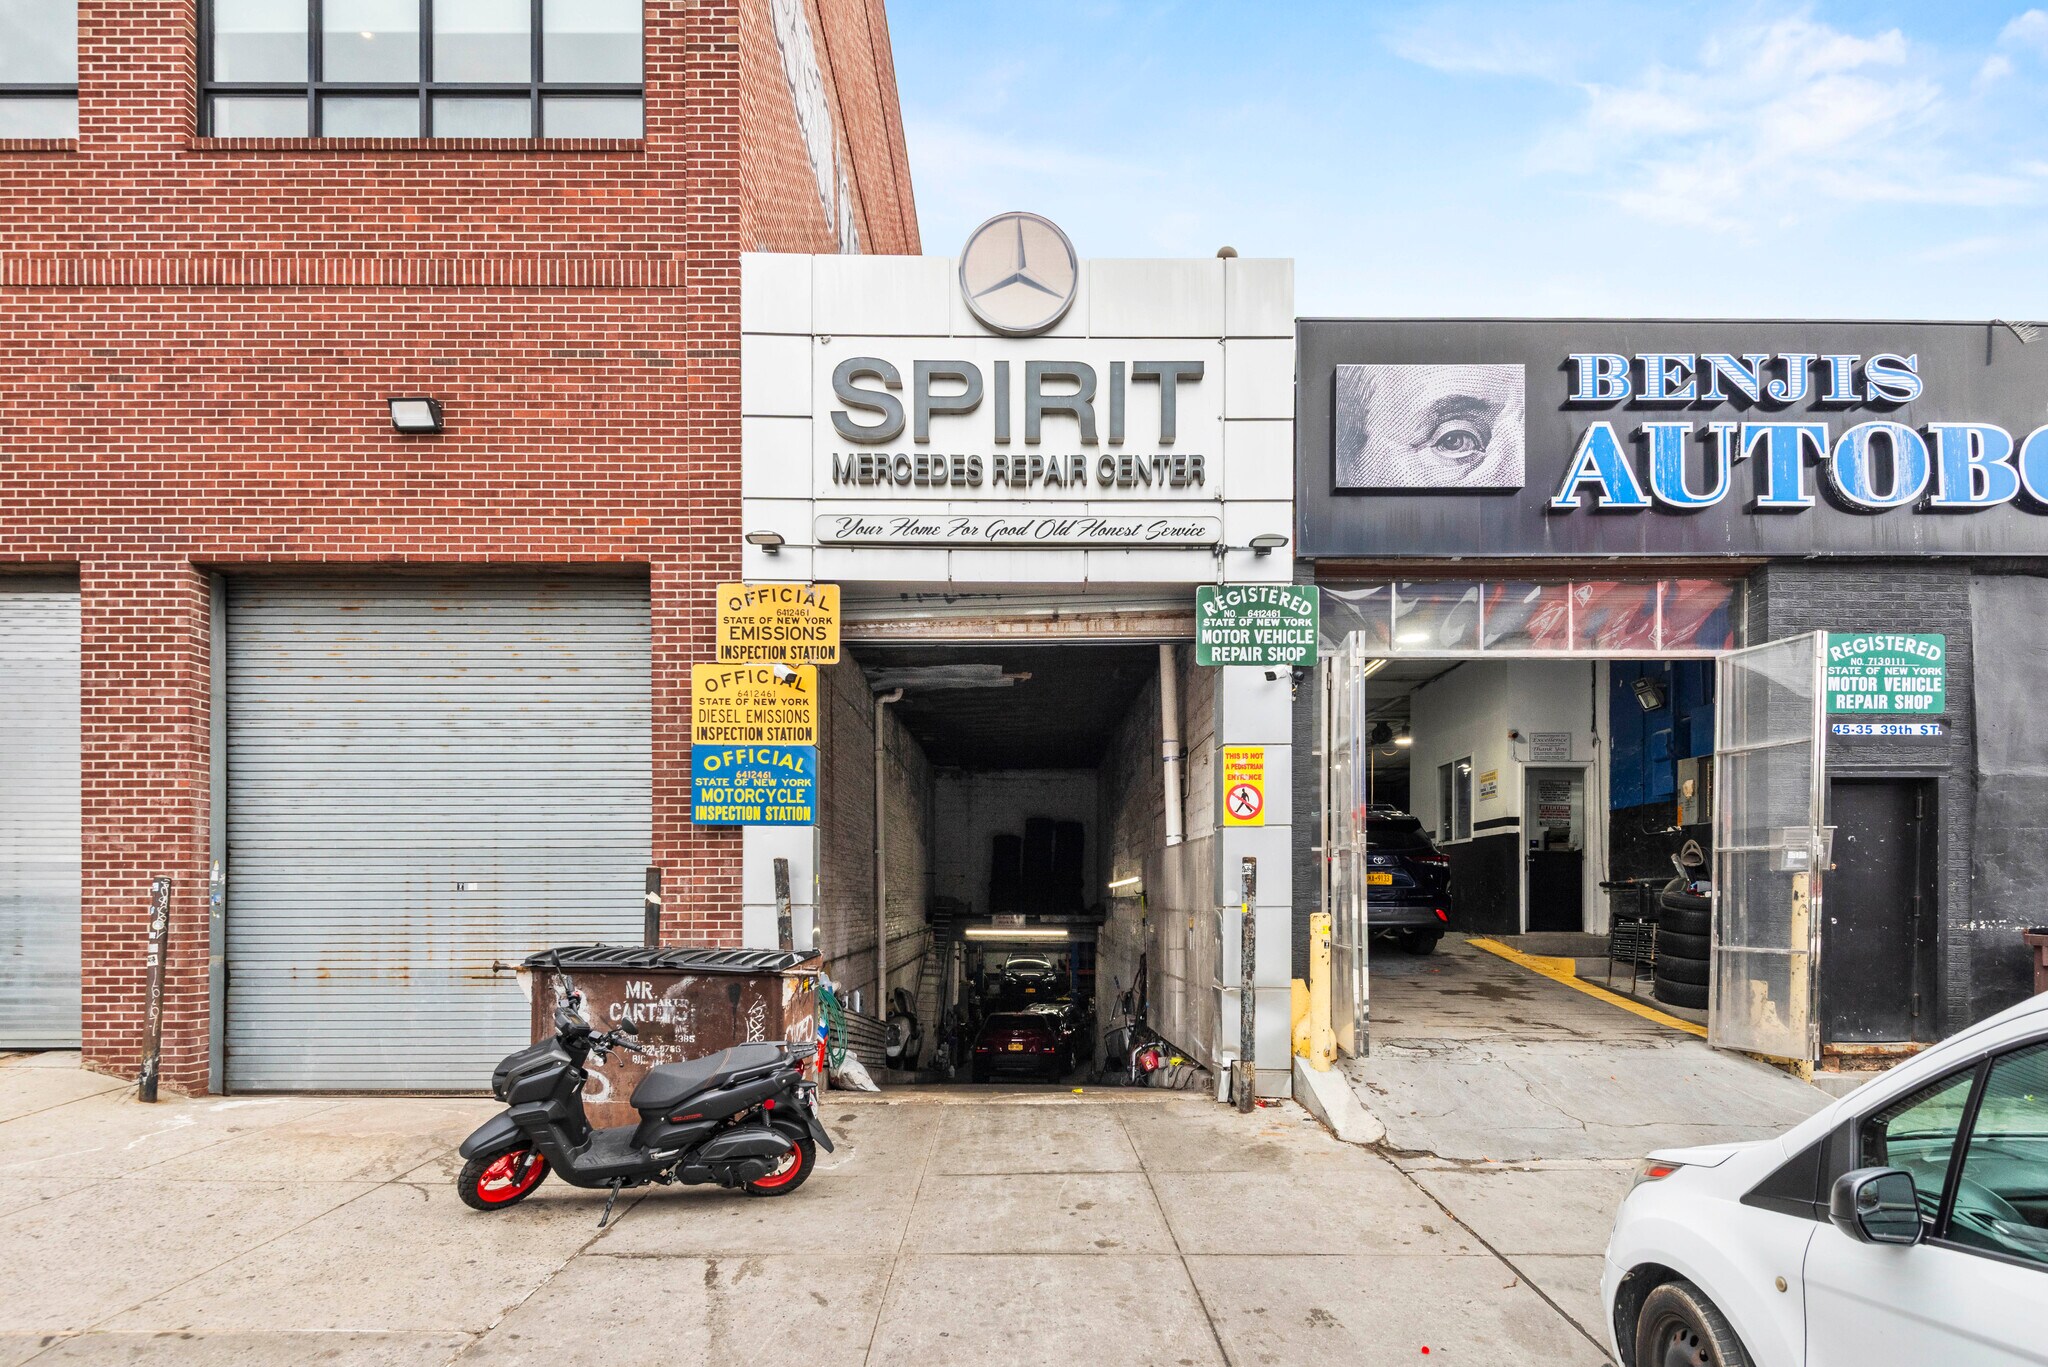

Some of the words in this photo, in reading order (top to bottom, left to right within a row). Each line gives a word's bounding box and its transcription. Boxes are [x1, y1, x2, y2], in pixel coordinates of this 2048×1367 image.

[1568, 353, 1923, 401] BENJIS
[831, 356, 1205, 444] SPIRIT
[832, 453, 983, 486] MERCEDES
[992, 454, 1088, 486] REPAIR
[1097, 454, 1205, 487] CENTER
[836, 517, 882, 538] Your
[890, 518, 940, 536] Home
[947, 518, 978, 536] For
[985, 520, 1035, 541] Good
[1035, 519, 1077, 539] Old
[1077, 518, 1143, 537] Honest
[1145, 520, 1206, 540] Service
[729, 588, 830, 612] OFFICIAL
[1203, 587, 1312, 616] REGISTERED
[776, 608, 810, 616] 6412461
[1224, 610, 1237, 618] NO.
[723, 617, 754, 625] STATE
[759, 617, 773, 625] OF
[777, 617, 798, 625] NEW
[804, 617, 833, 625] YORK
[1203, 618, 1235, 626] STATE
[1239, 618, 1253, 626] OF
[1257, 618, 1280, 626] NEW
[1283, 618, 1312, 626] YORK
[730, 627, 827, 641] EMISSIONS
[1202, 629, 1249, 644] MOTOR
[1254, 629, 1314, 644] VEHICLE
[721, 645, 786, 660] INSPECTION
[790, 645, 835, 660] STATION
[1212, 647, 1262, 661] REPAIR
[1268, 647, 1306, 661] SHOP
[1830, 636, 1941, 661] REGISTERED
[1828, 667, 1861, 675] STATE
[1866, 667, 1880, 675] OF
[1828, 677, 1877, 692] MOTOR
[1884, 677, 1942, 692] VEHICLE
[738, 690, 776, 698] 6412461
[1836, 694, 1888, 709] REPAIR
[1895, 694, 1933, 709] SHOP
[699, 698, 731, 706] STATE
[736, 698, 749, 706] OF
[754, 698, 776, 706] NEW
[781, 698, 809, 706] YORK
[699, 709, 741, 724] DIESEL
[746, 709, 810, 724] EMISSIONS
[697, 726, 763, 741] INSPECTION
[767, 727, 812, 741] STATION
[1833, 725, 1873, 734] 45-35
[1881, 725, 1912, 734] 39th
[1920, 725, 1941, 734] ST.
[703, 749, 804, 773] OFFICIAL
[695, 778, 729, 786] STATE
[734, 778, 748, 786] OF
[754, 778, 777, 786] NEW
[782, 778, 811, 787] YORK
[736, 771, 771, 779] 6412461
[701, 788, 805, 803] MOTORCYCLE
[696, 806, 761, 821] INSPECTION
[765, 806, 811, 821] STATION
[626, 980, 658, 1000] MR.
